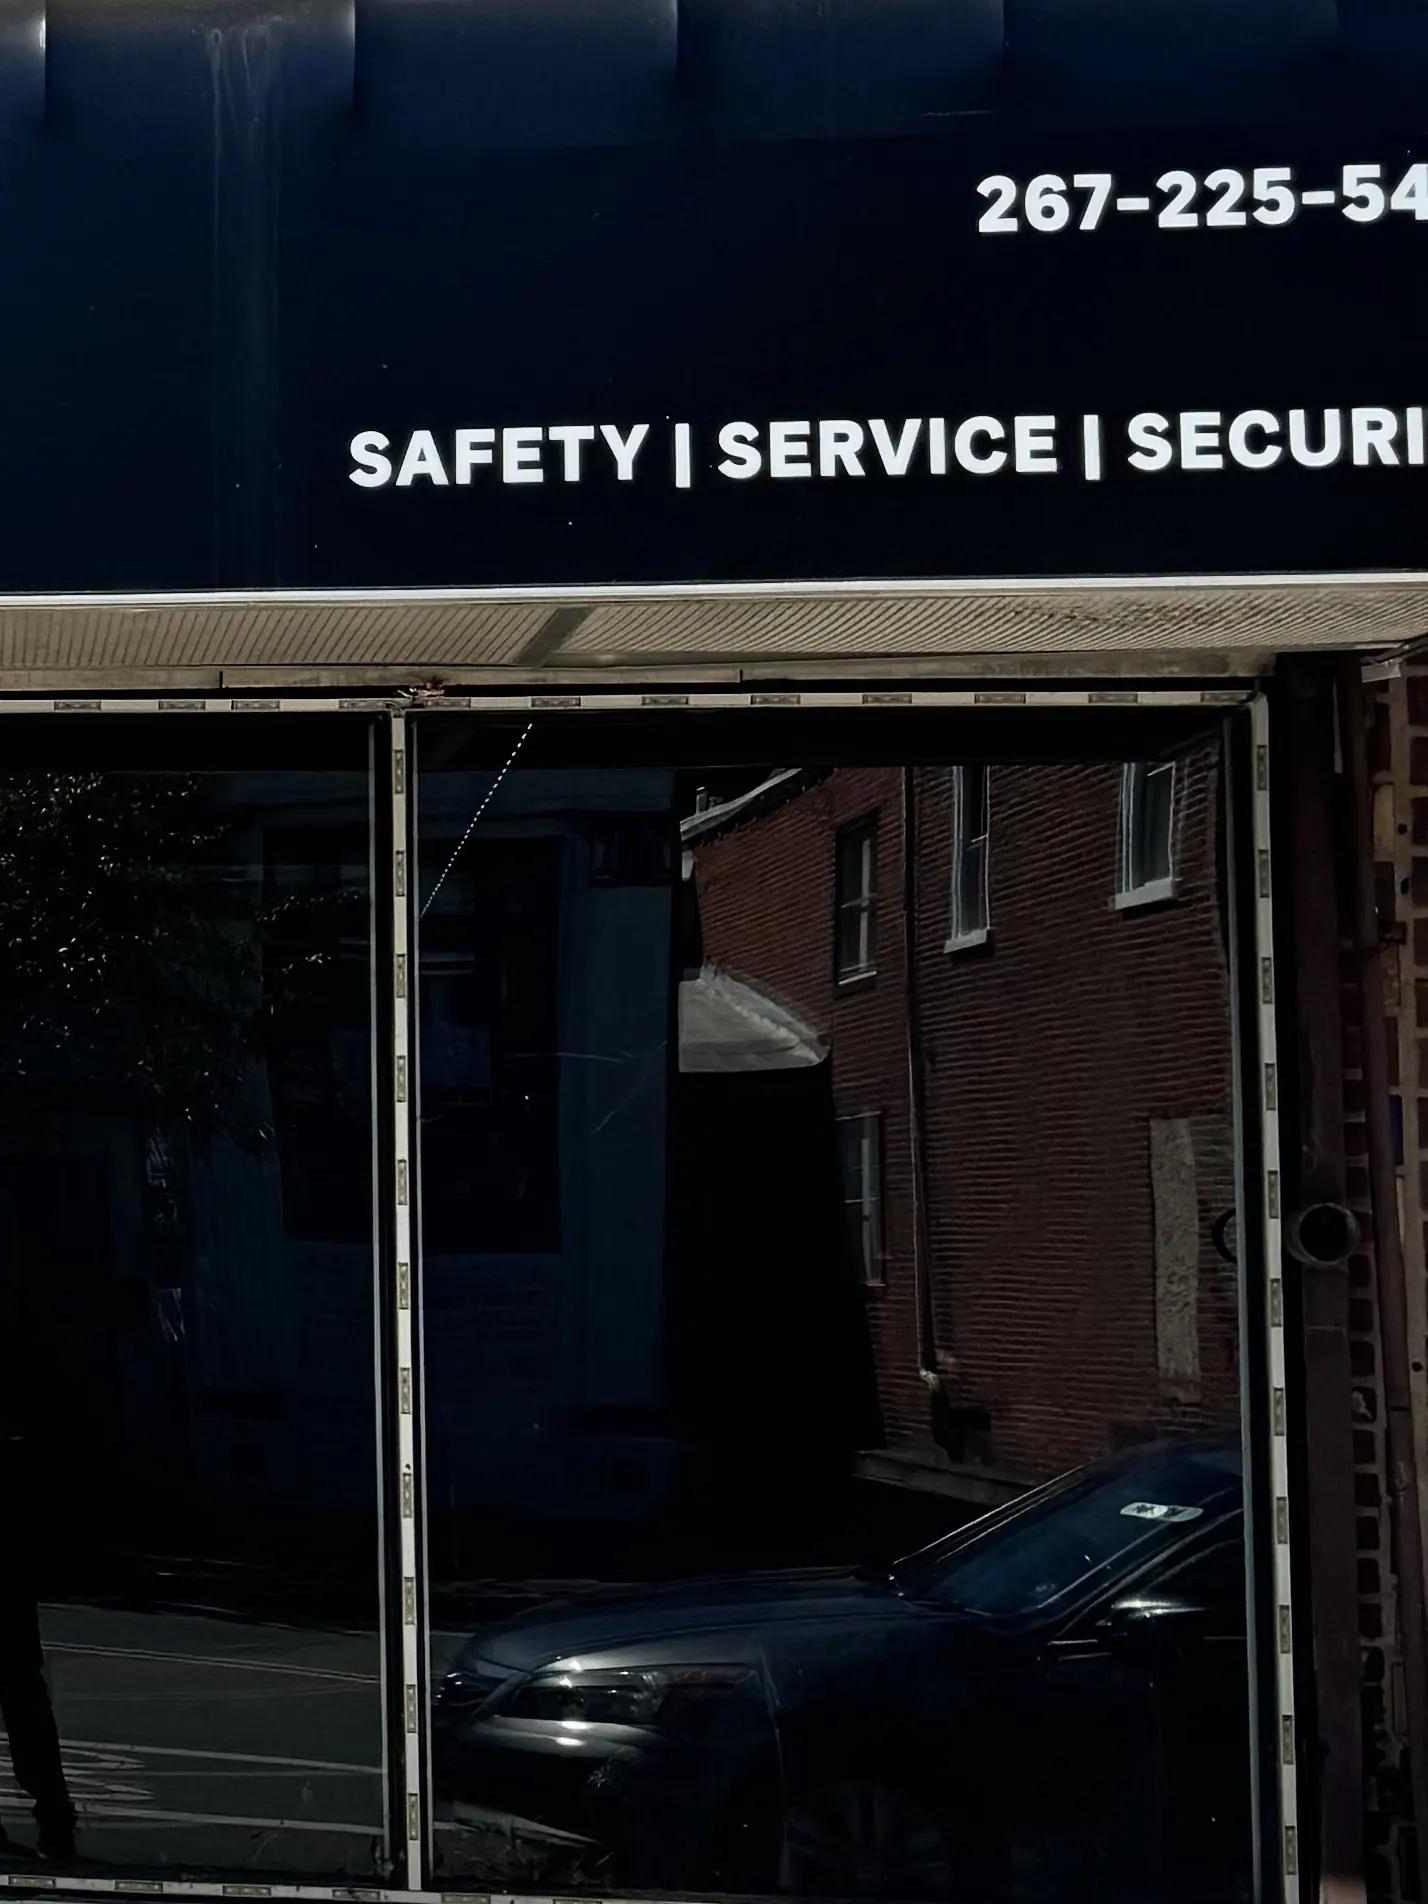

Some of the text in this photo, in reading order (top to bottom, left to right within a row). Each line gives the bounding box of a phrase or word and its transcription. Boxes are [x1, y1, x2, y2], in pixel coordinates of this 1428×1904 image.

[348, 423, 650, 488] SAFETY
[717, 414, 1058, 480] SERVICE
[1127, 406, 1425, 471] SECURI
